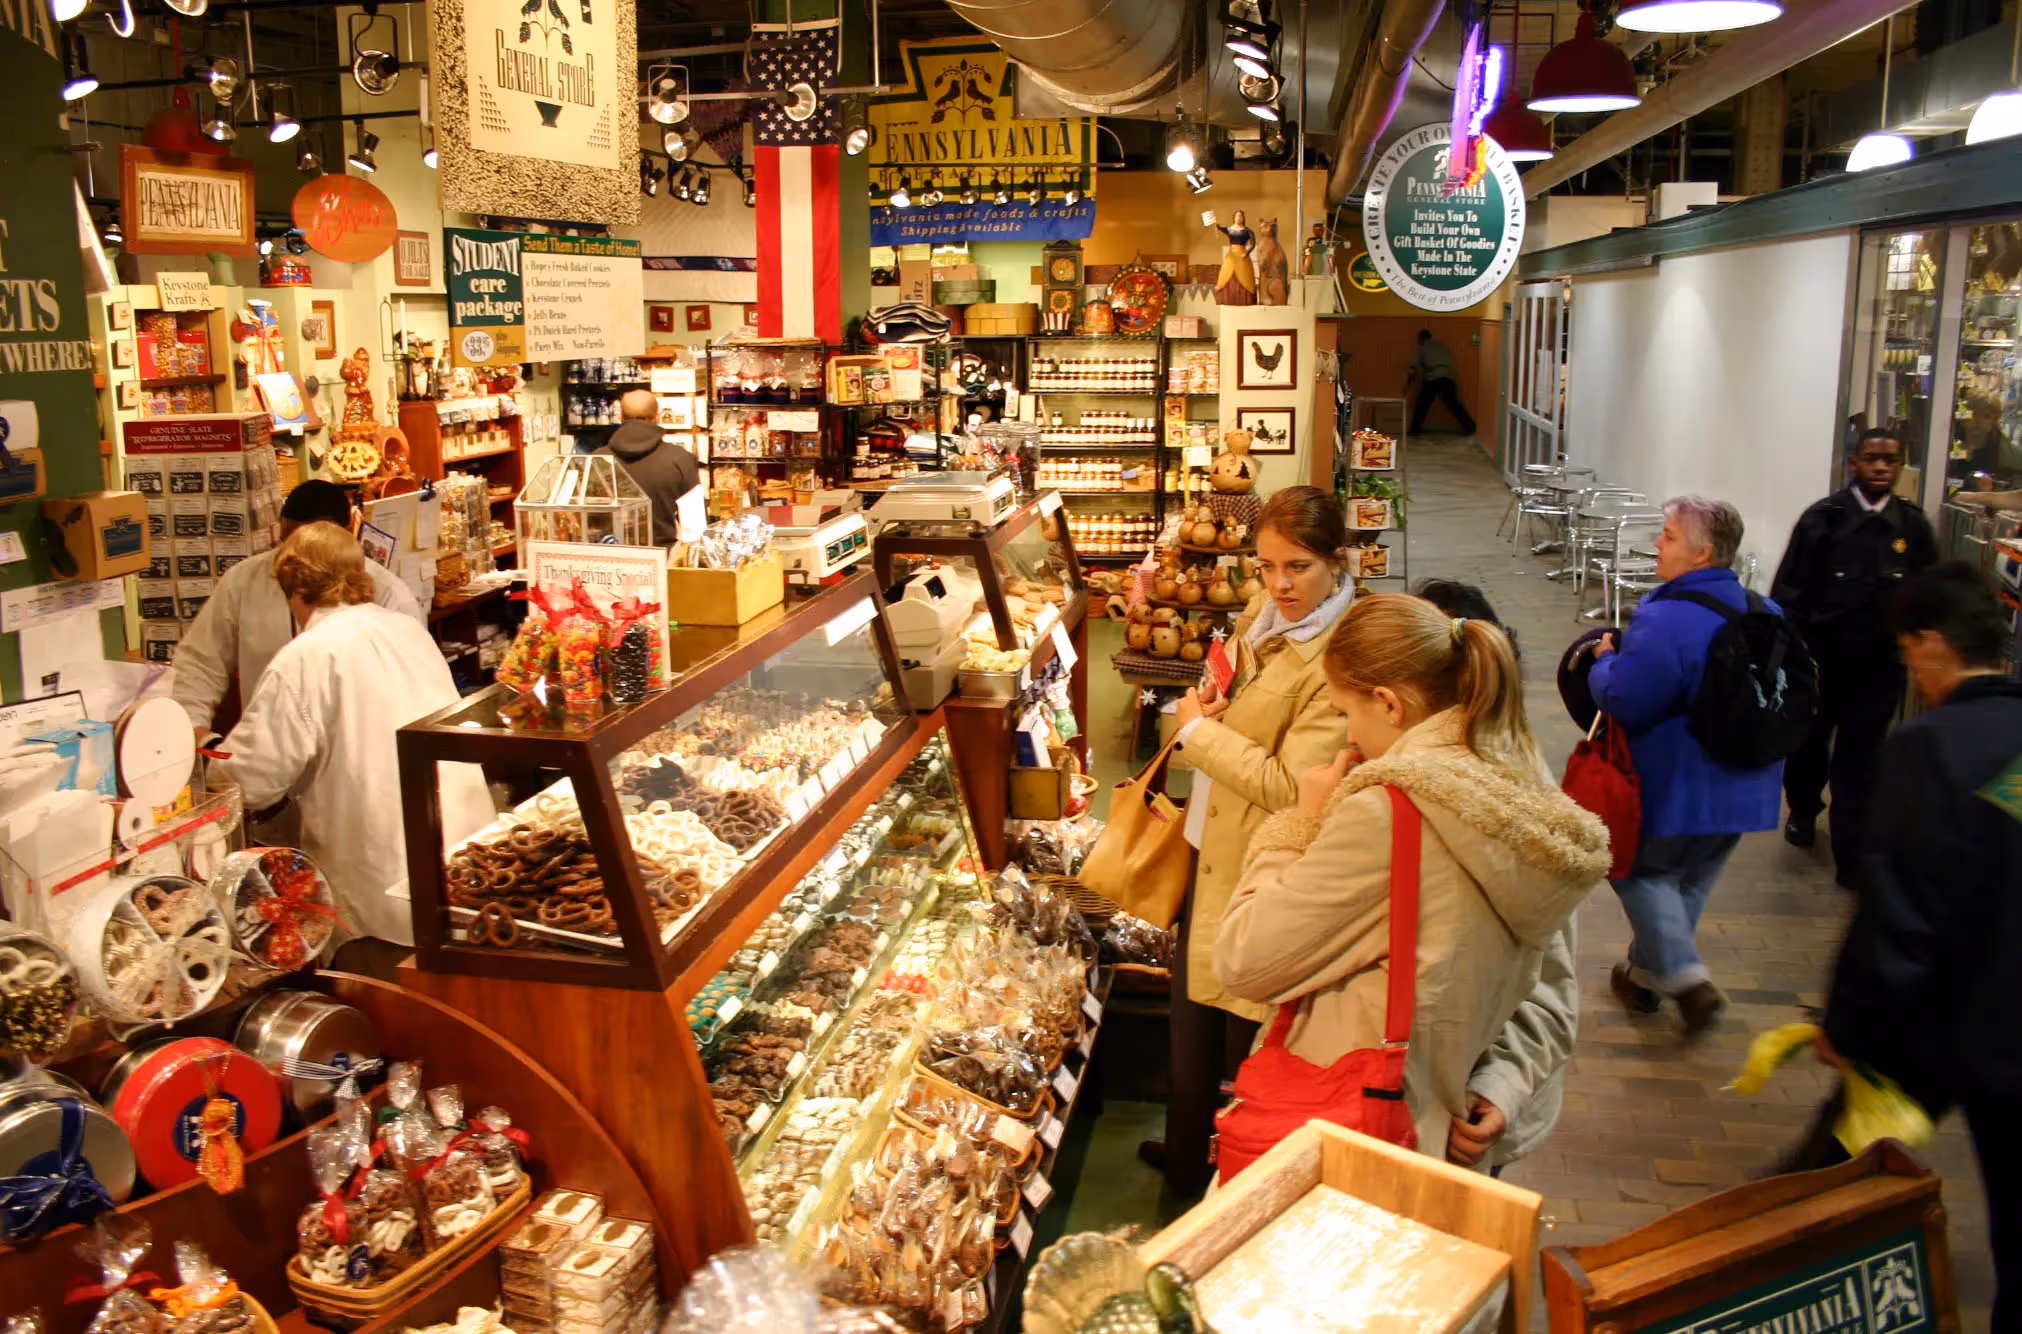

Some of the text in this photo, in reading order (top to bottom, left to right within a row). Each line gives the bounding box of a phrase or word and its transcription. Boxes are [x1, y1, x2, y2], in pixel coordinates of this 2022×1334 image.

[495, 28, 594, 107] GENERAL STORE
[1368, 165, 1392, 241] CREATE
[1387, 131, 1429, 165] YOUR
[1407, 176, 1488, 198] PENNSVANIA
[138, 176, 241, 230] PENNSYLVANIA
[946, 209, 981, 221] made
[983, 208, 1024, 221] foods
[1029, 207, 1039, 218] &
[1044, 206, 1088, 220] crafts
[1415, 209, 1478, 222] Invites You To
[901, 222, 1022, 237] Shipping Available
[1411, 222, 1481, 236] Build Your Own
[524, 235, 641, 256] Send Them a Taste of Home!
[1394, 235, 1496, 250] Gift Basket Of Goodies
[452, 234, 521, 276] STUDENT
[1416, 249, 1473, 263] Made In The
[552, 261, 569, 271] Fresh
[570, 262, 588, 273] Baked
[1411, 263, 1478, 278] Keystone State
[162, 278, 209, 292] Keystone
[470, 277, 507, 293] care
[531, 277, 561, 288] Chocolate
[1391, 274, 1406, 289] The
[1407, 286, 1425, 301] Best
[1427, 295, 1438, 306] of
[1440, 277, 1497, 305] Pennsylvania
[165, 292, 197, 305] Krafts
[455, 294, 523, 325] package
[533, 309, 567, 321] Jelly Beans
[534, 341, 551, 354] Party
[552, 340, 564, 351] Mix
[150, 425, 213, 435] GENUINE SLATE
[543, 564, 613, 590] Thanksgiving
